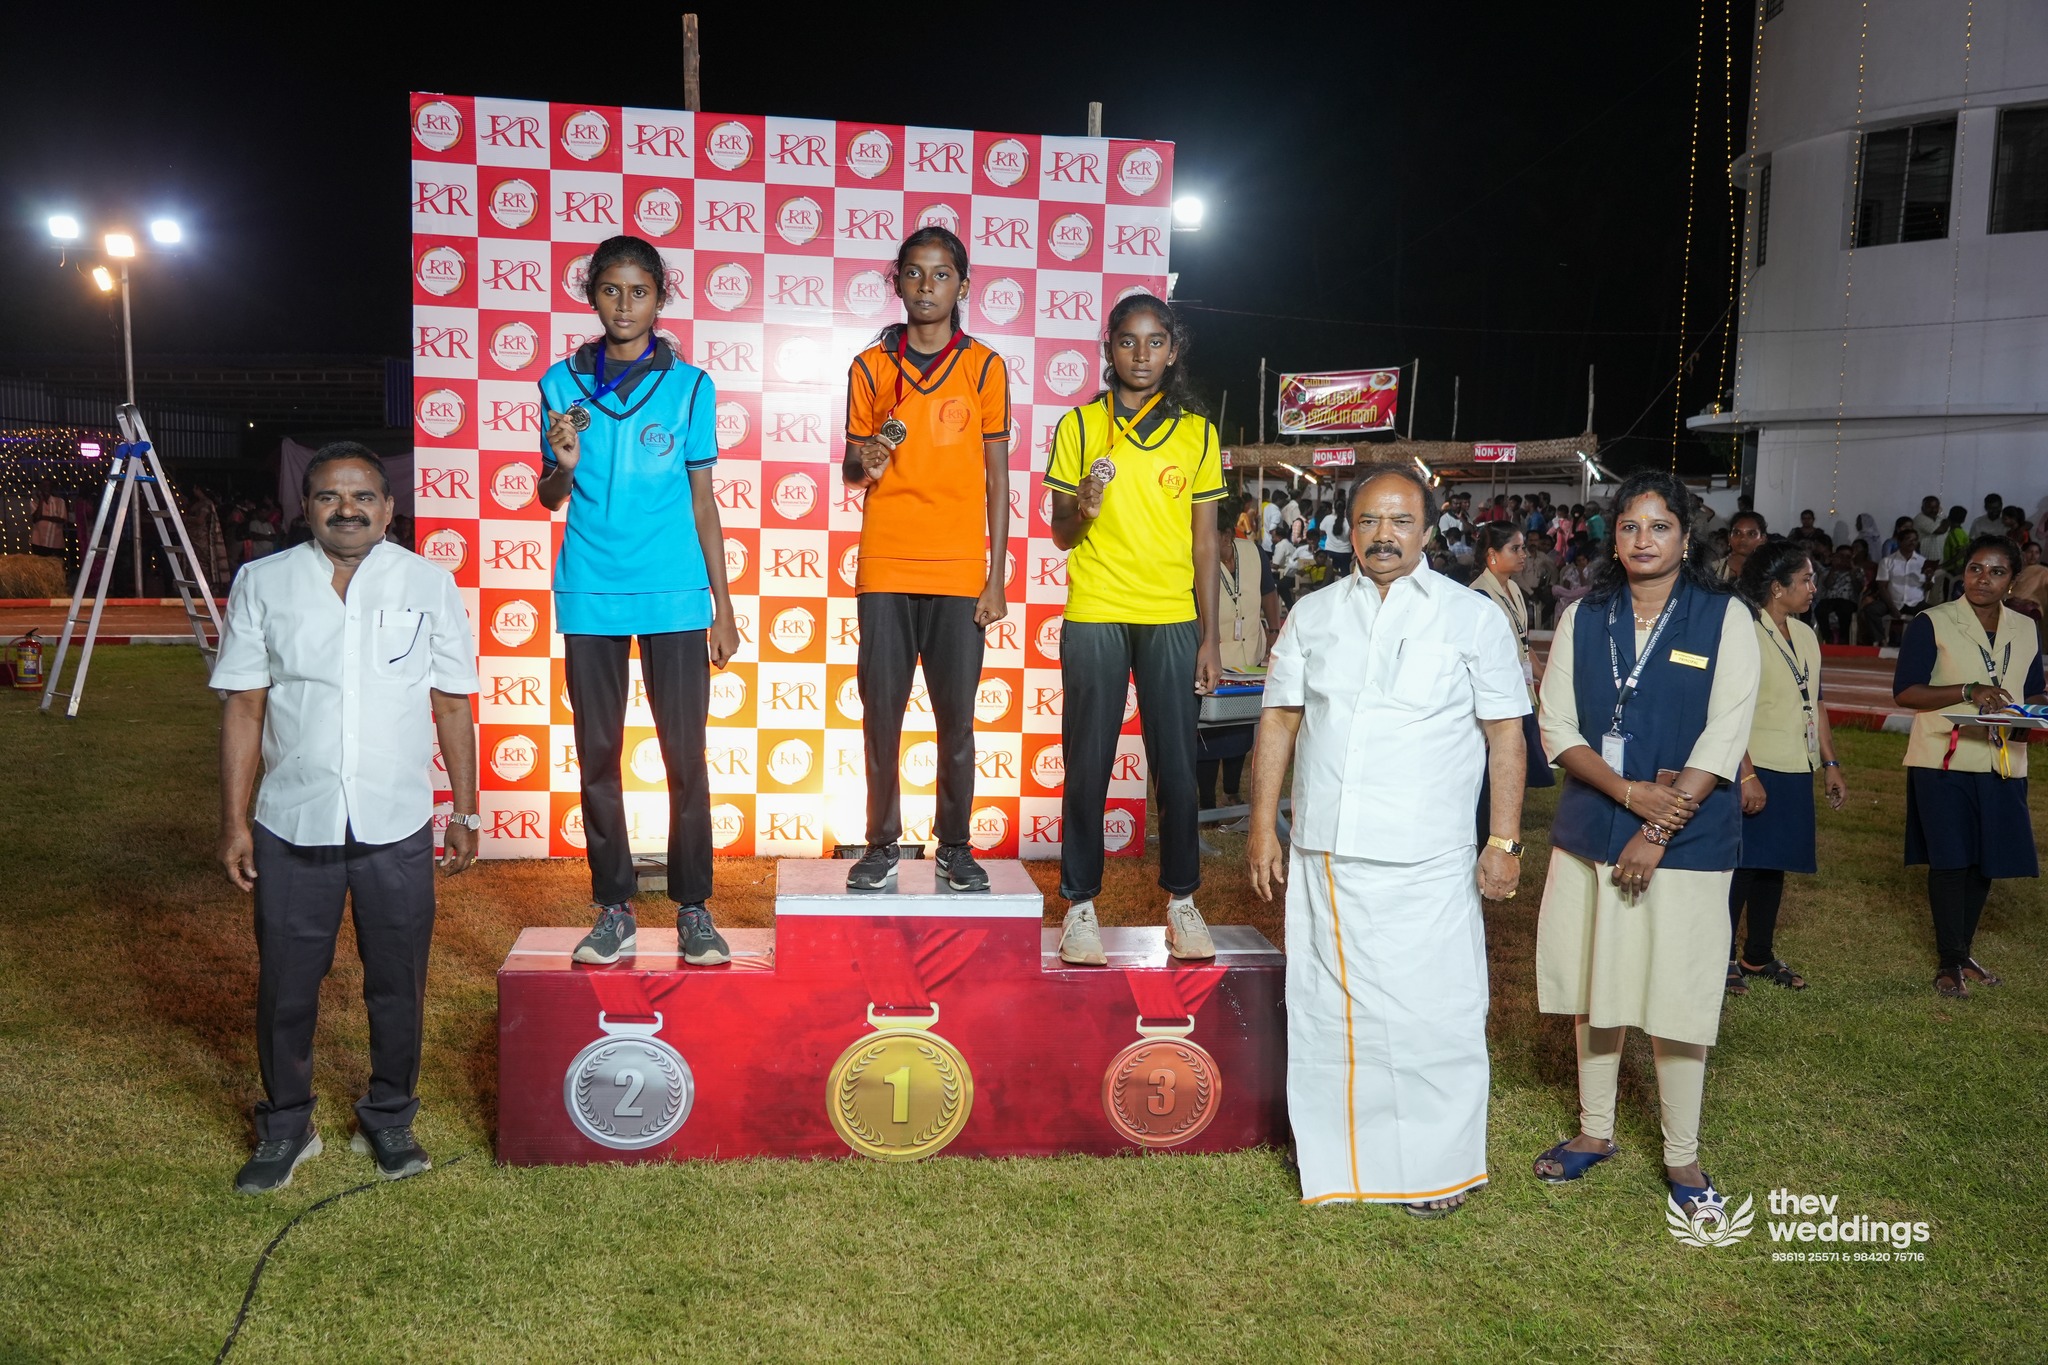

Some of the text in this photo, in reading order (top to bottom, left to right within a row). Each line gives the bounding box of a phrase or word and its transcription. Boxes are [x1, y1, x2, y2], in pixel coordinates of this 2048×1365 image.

[482, 115, 546, 149] RR
[628, 124, 690, 158] RR
[770, 133, 831, 166] RR
[909, 142, 969, 175] RR
[1045, 151, 1102, 184] RR
[412, 182, 473, 216] RR
[555, 192, 619, 225] RR
[699, 200, 761, 233] RR
[839, 208, 899, 241] RR
[975, 216, 1034, 248] RR
[1108, 225, 1165, 257] RR
[483, 259, 546, 292] RR
[664, 267, 689, 299] R
[768, 274, 829, 306] RR
[1040, 289, 1097, 321] RR
[413, 326, 474, 359] RR
[483, 400, 540, 432] RR
[1314, 450, 1353, 461] NON-VEG
[414, 467, 475, 499] RR
[484, 539, 546, 570] RR
[764, 548, 824, 578] RR
[1633, 663, 1642, 677] RR
[484, 676, 546, 706] RR
[762, 682, 821, 710] RR
[484, 811, 545, 839] RR
[613, 1068, 644, 1117] 2
[883, 1066, 909, 1124] 1
[1147, 1069, 1177, 1117] 3
